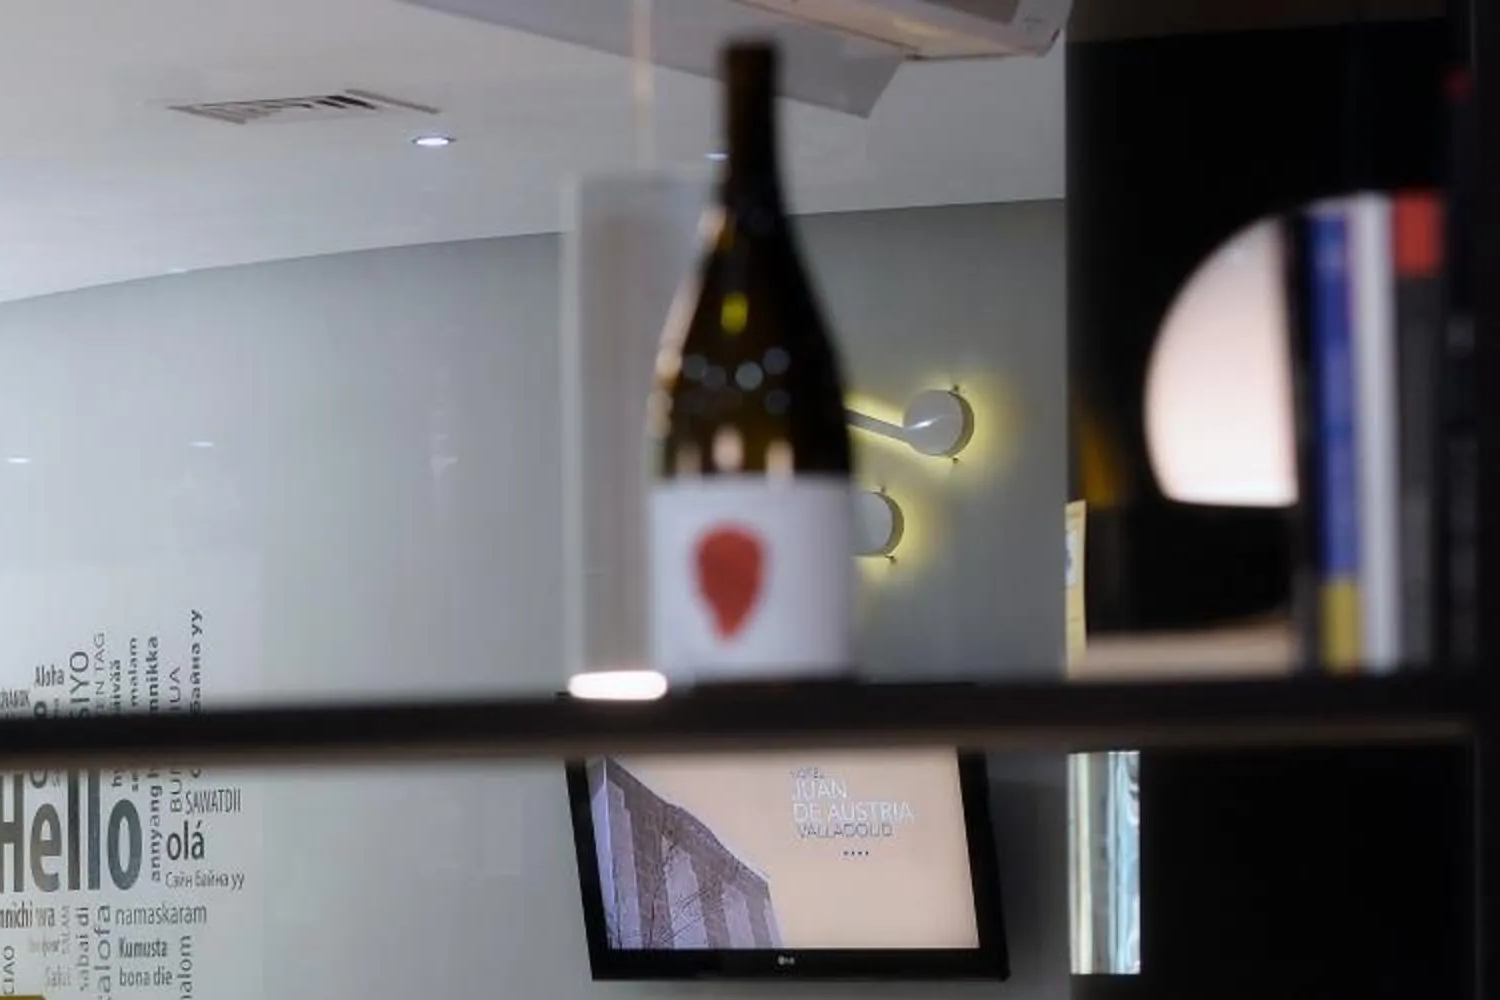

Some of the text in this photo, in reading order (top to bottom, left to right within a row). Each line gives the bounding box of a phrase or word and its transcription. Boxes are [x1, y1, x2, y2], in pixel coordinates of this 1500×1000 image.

[35, 664, 65, 688] Aloha
[69, 651, 90, 719] SIYO
[792, 778, 848, 800] JUAN
[793, 801, 915, 825] DE AUSTRIA
[167, 820, 205, 861] olá
[115, 903, 207, 926] namaskaram
[119, 938, 168, 958] Kumusta
[3, 945, 16, 995] CIAO
[119, 966, 173, 987] bona die
